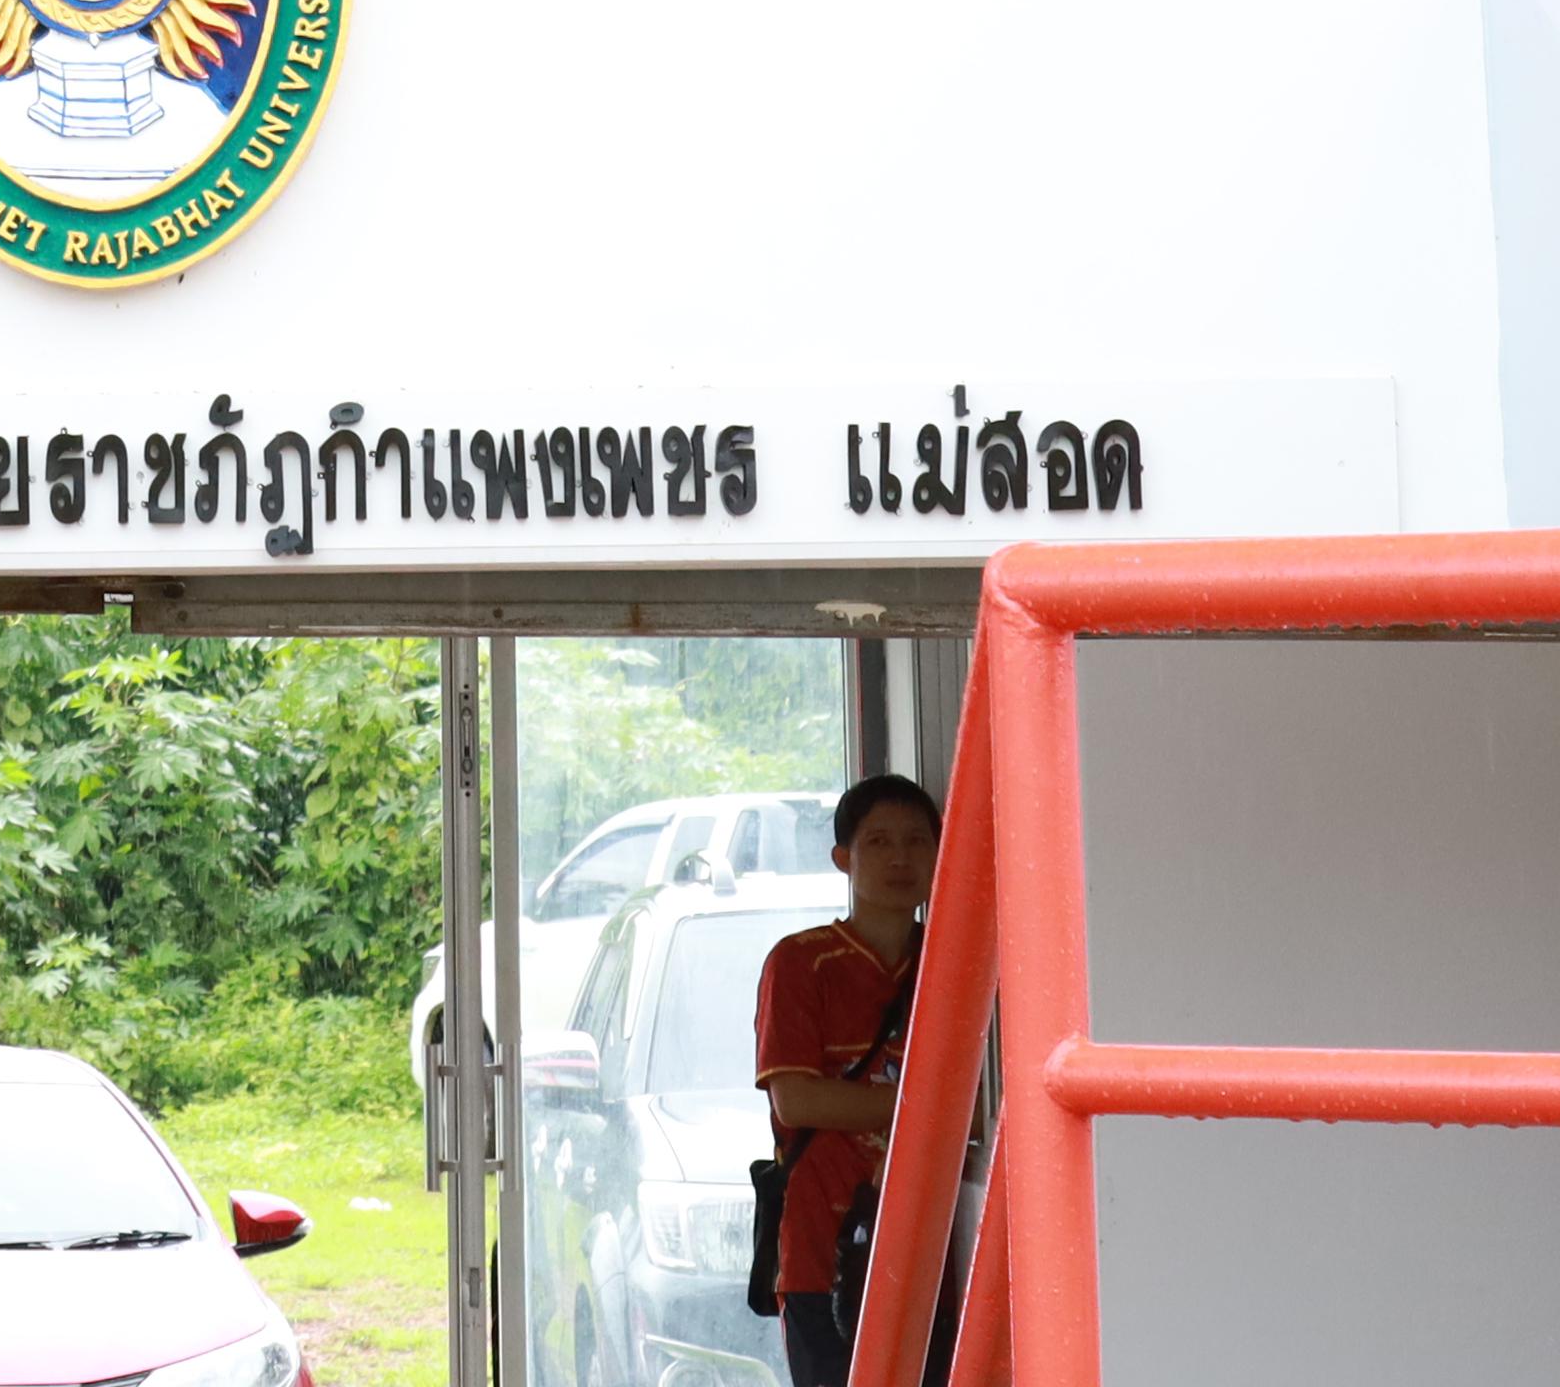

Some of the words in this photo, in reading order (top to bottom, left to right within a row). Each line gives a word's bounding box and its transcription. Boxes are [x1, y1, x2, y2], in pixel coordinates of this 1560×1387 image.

[63, 168, 247, 270] RAJABHAT
[847, 384, 1144, 516] แม่สอด
